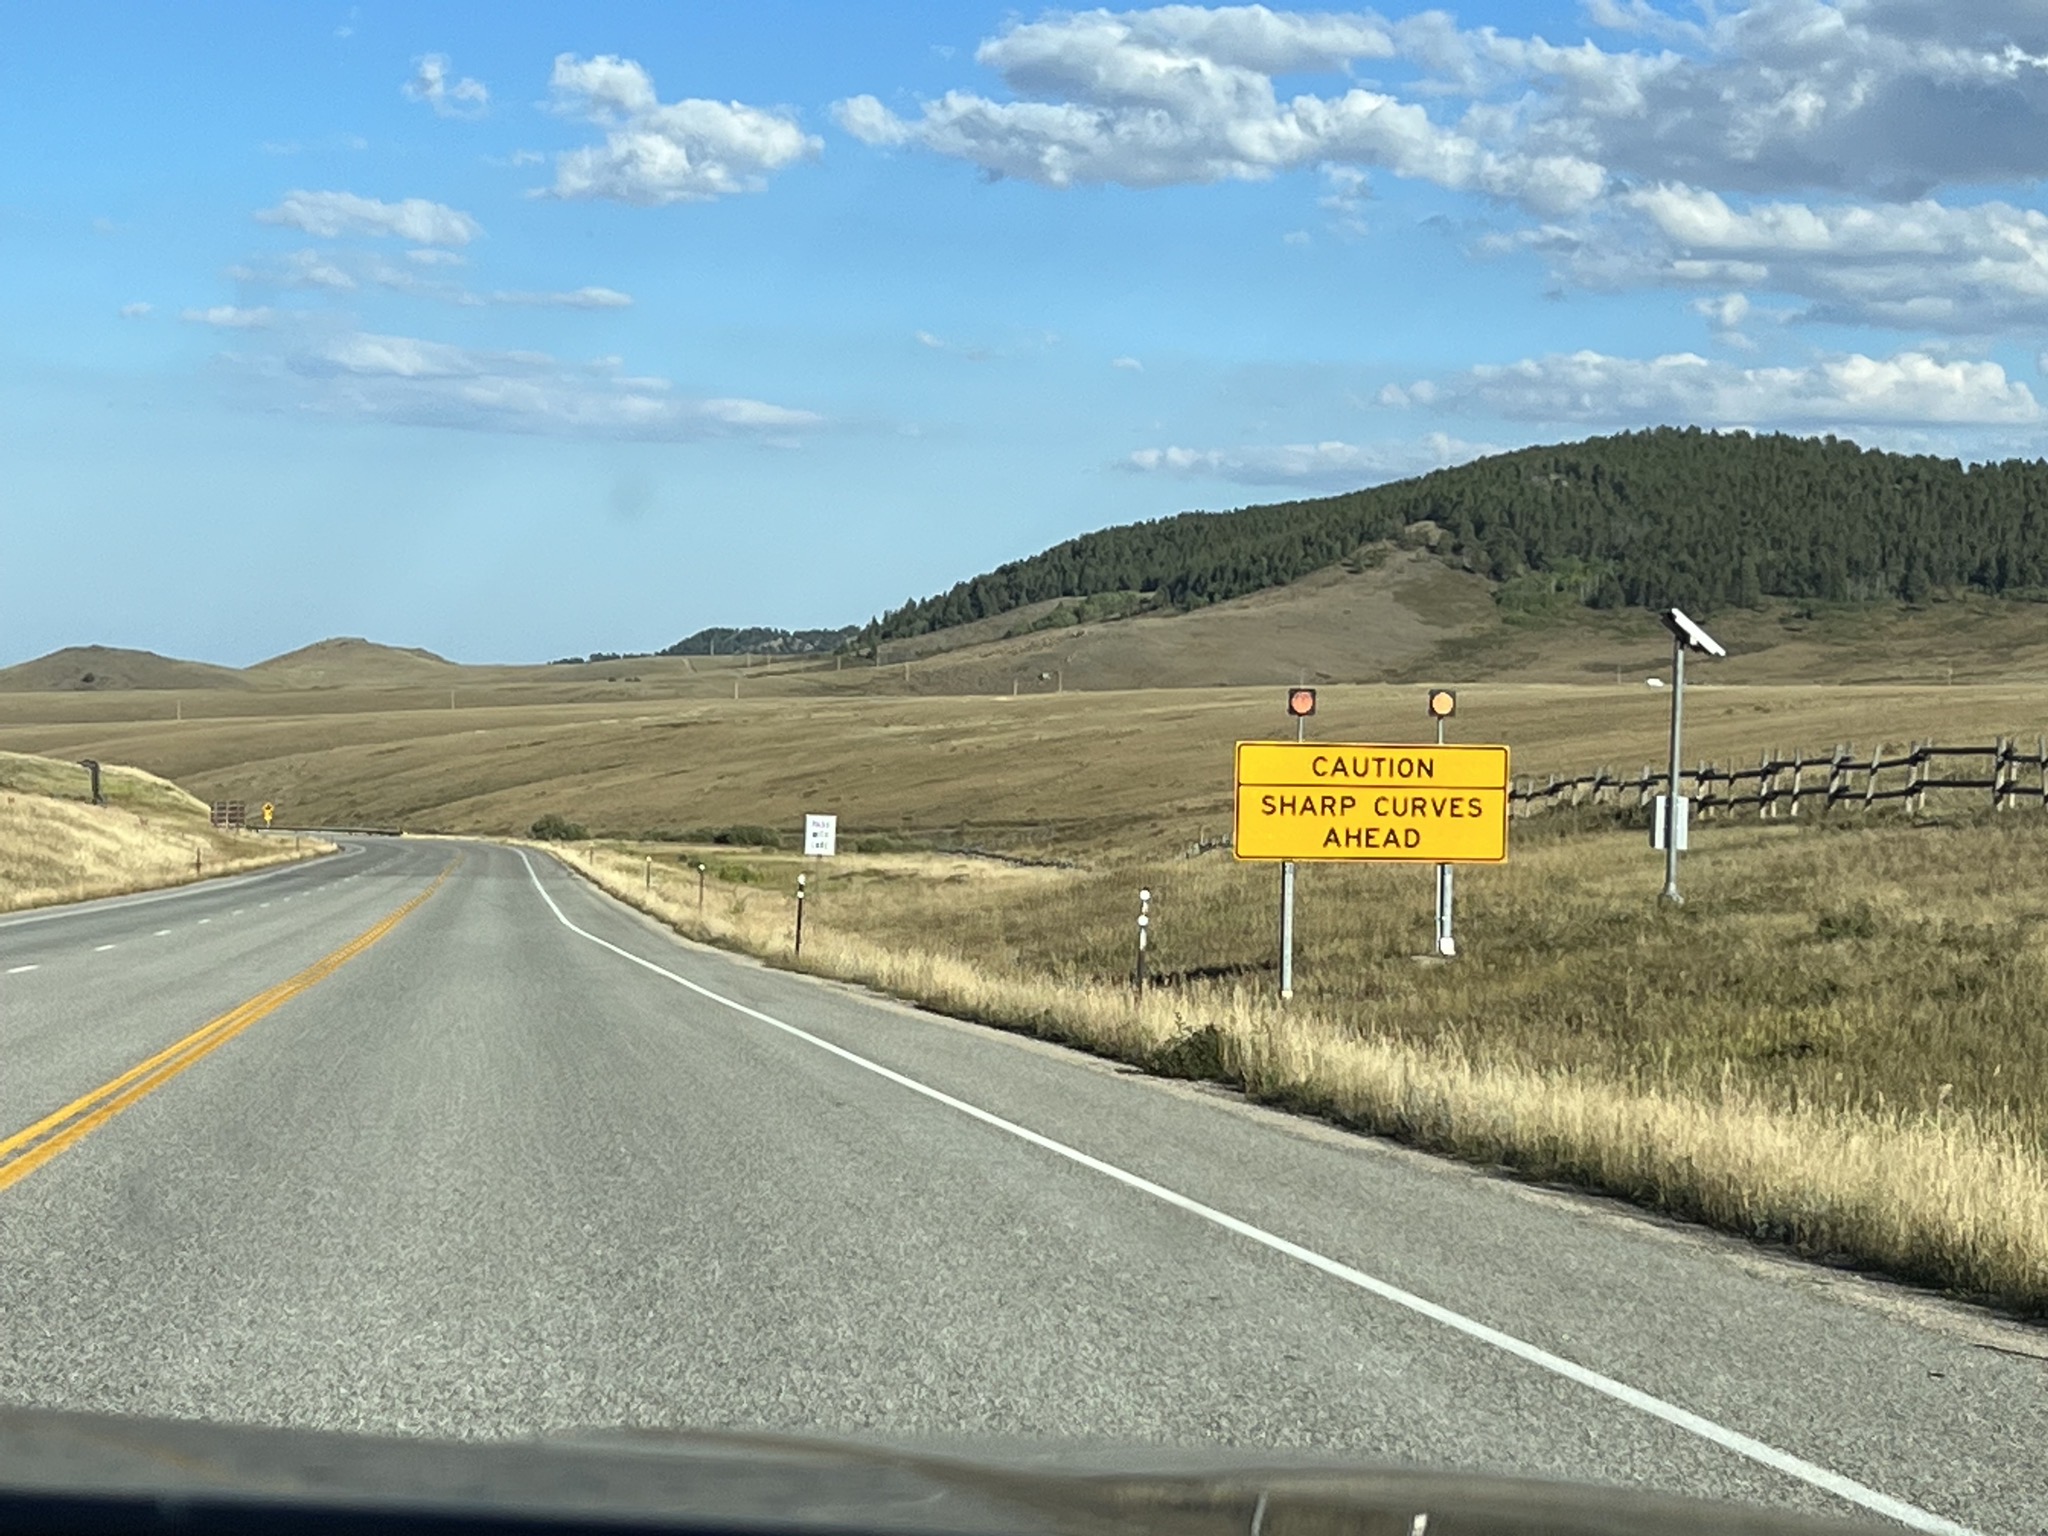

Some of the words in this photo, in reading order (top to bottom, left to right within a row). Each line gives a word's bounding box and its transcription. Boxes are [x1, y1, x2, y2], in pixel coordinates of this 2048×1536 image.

[1312, 756, 1435, 778] CAUTION
[1261, 795, 1356, 816] SHARP
[1374, 796, 1482, 818] CURVES
[1322, 828, 1421, 848] AHEAD
